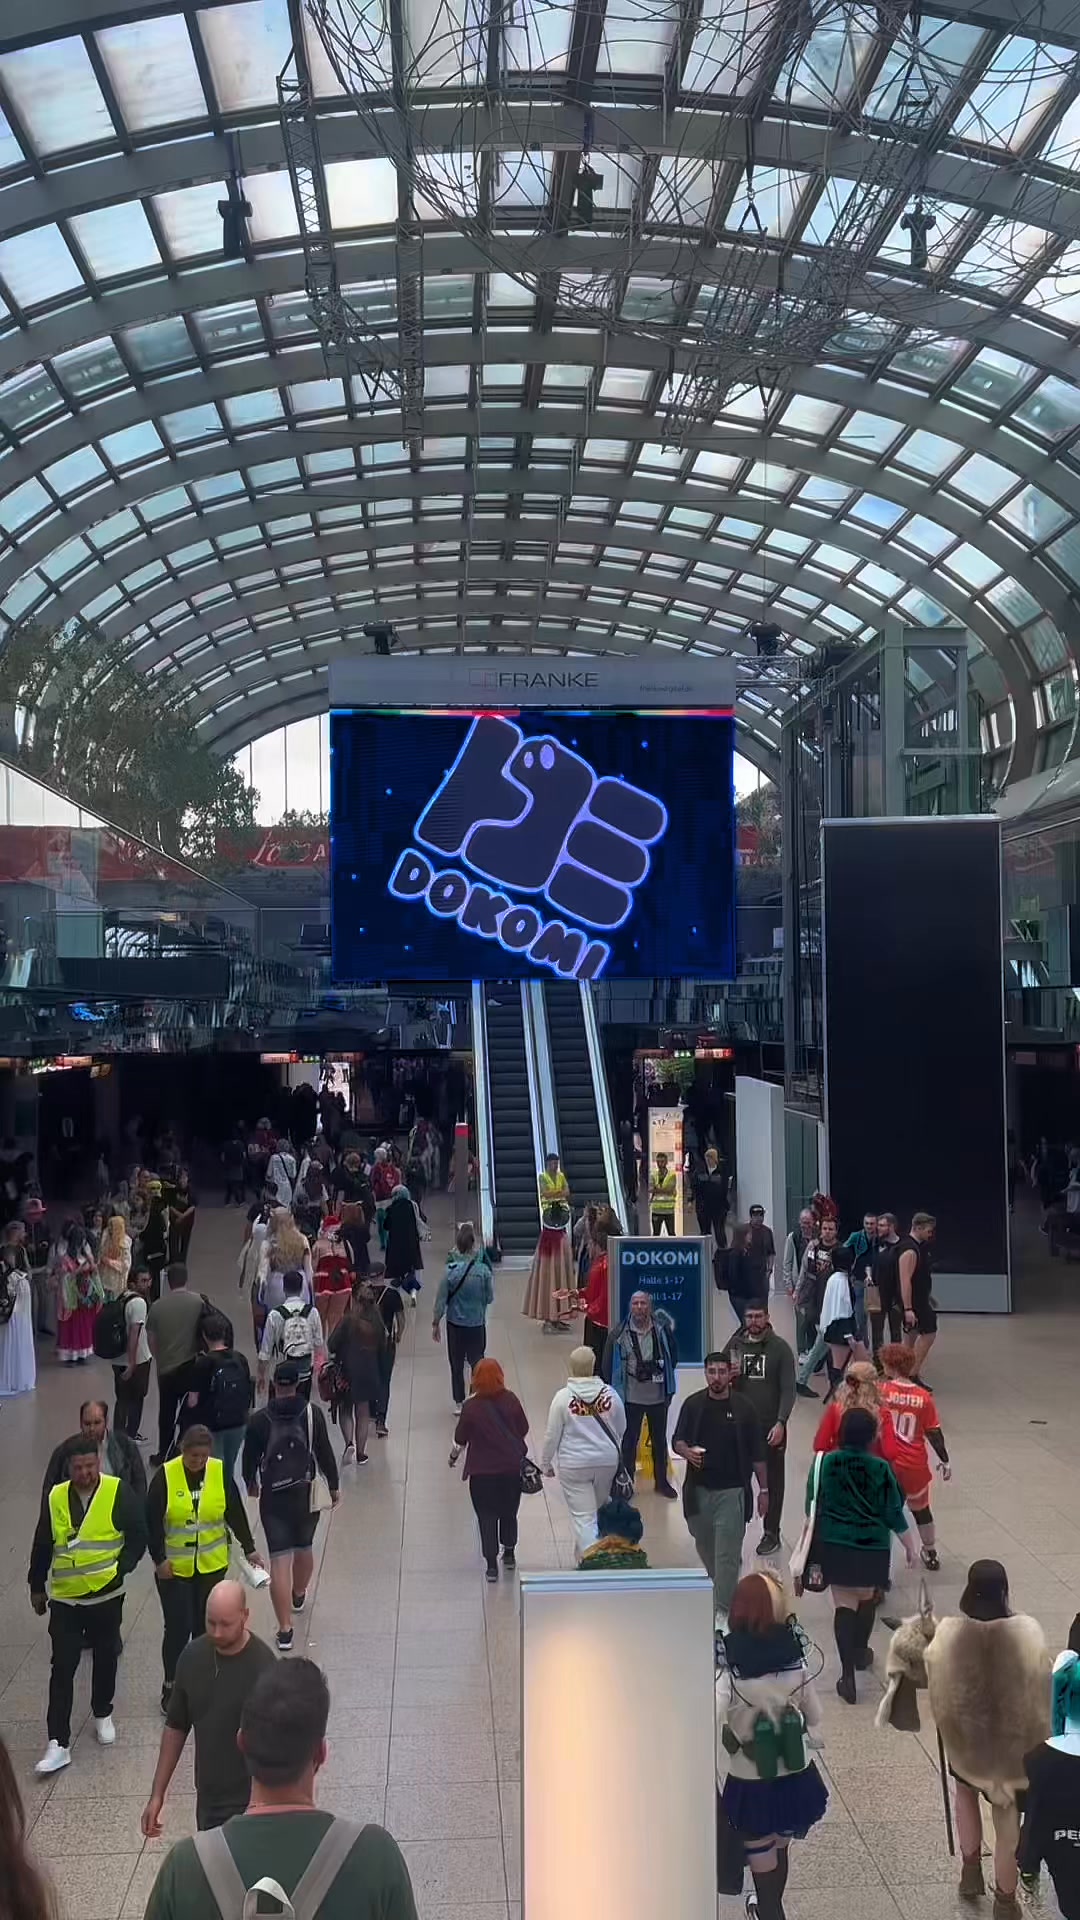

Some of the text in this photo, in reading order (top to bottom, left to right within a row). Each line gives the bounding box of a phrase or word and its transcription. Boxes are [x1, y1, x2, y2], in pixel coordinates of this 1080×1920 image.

[499, 672, 599, 688] FRANKE
[388, 848, 610, 980] DOKOMI
[622, 1251, 699, 1265] DOKOMI
[639, 1276, 685, 1285] Halle 1-17
[662, 1292, 682, 1301] 1-17
[891, 1410, 917, 1445] 10
[1054, 1829, 1080, 1841] PE
